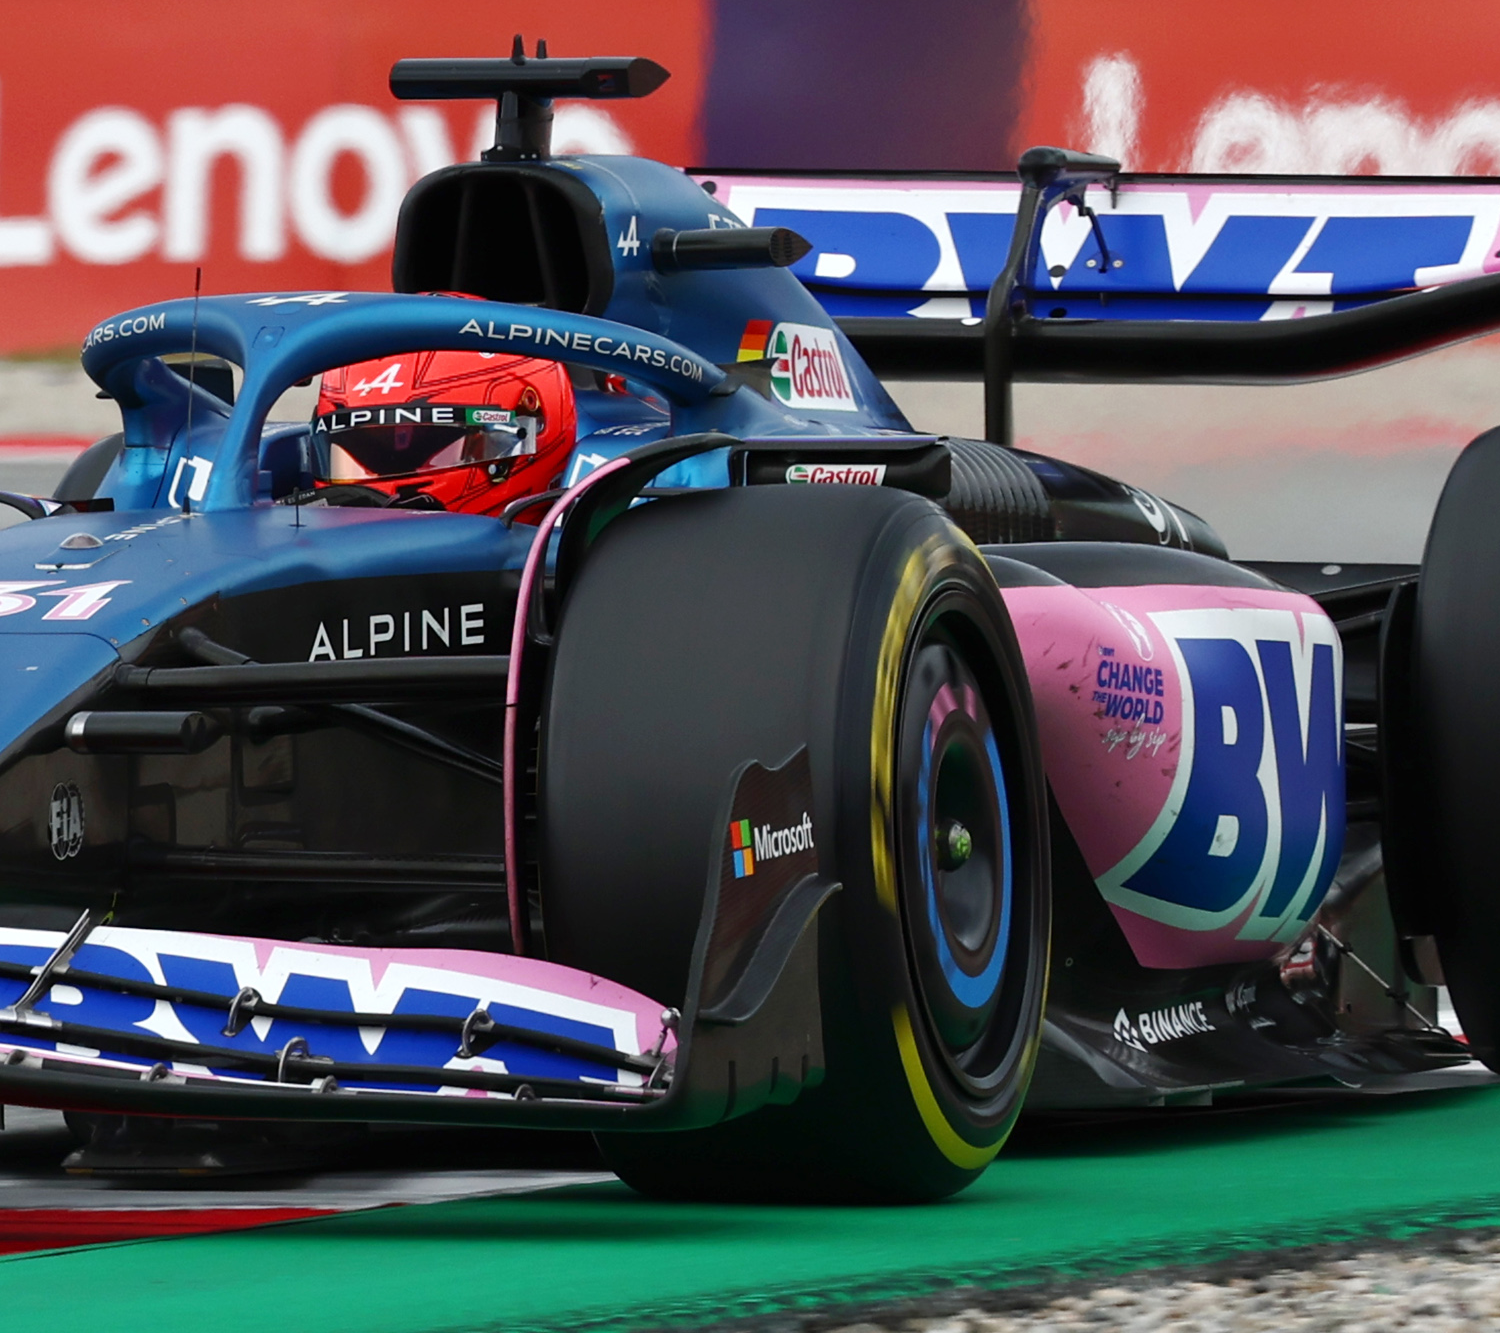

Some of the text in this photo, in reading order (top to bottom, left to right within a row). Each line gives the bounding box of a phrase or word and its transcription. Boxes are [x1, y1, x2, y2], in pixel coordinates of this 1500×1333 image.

[459, 318, 703, 382] ALPINECARS.COM
[792, 334, 850, 399] Castrol
[315, 407, 454, 434] ALPINE
[481, 412, 511, 423] Castrol
[810, 467, 879, 486] Castrol
[308, 602, 485, 663] ALPINE
[1097, 659, 1164, 697] CHANGE
[1092, 691, 1107, 704] THE
[1105, 694, 1164, 725] WORLD
[1146, 726, 1167, 757] sip
[753, 811, 815, 862] Microsoft
[1138, 1002, 1217, 1044] BINANCE
